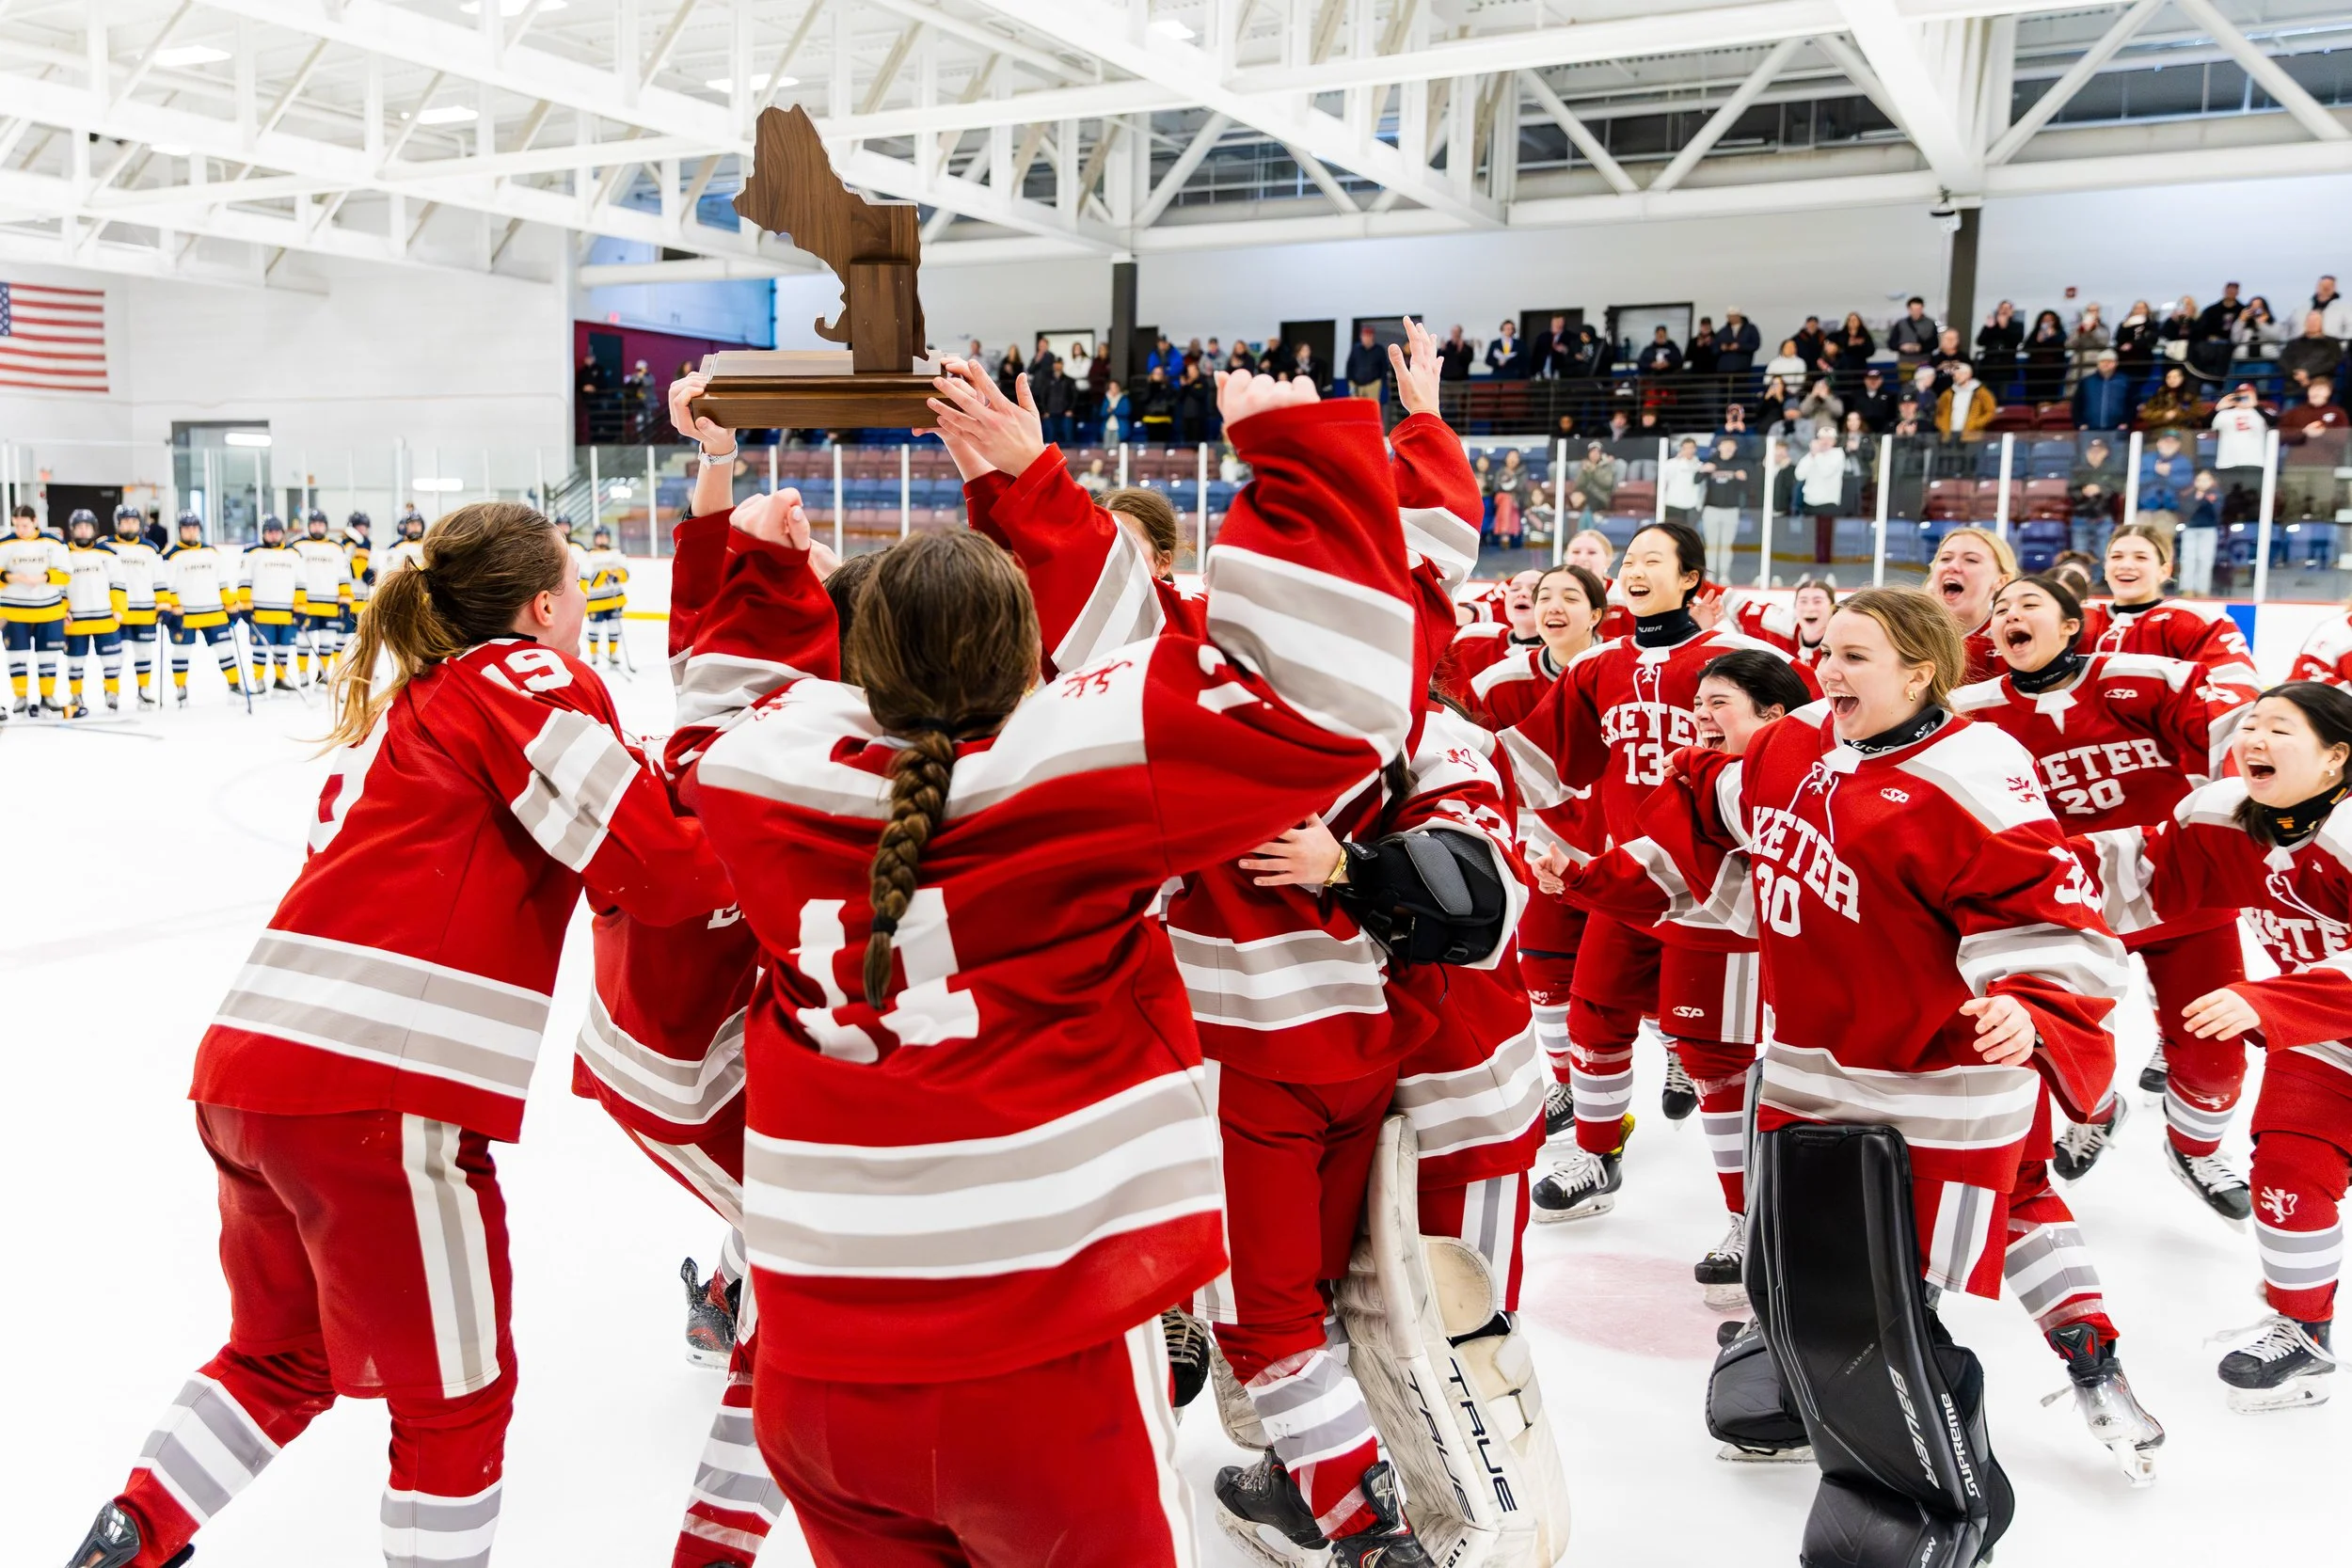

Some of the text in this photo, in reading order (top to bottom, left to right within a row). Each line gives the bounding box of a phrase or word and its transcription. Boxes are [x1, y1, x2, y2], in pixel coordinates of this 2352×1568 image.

[1624, 742, 1664, 786] 13
[2057, 778, 2126, 815] 20
[1408, 1369, 1475, 1522] TRUE
[1449, 1356, 1518, 1513] TRUE
[1888, 1365, 1941, 1489] BAUER
